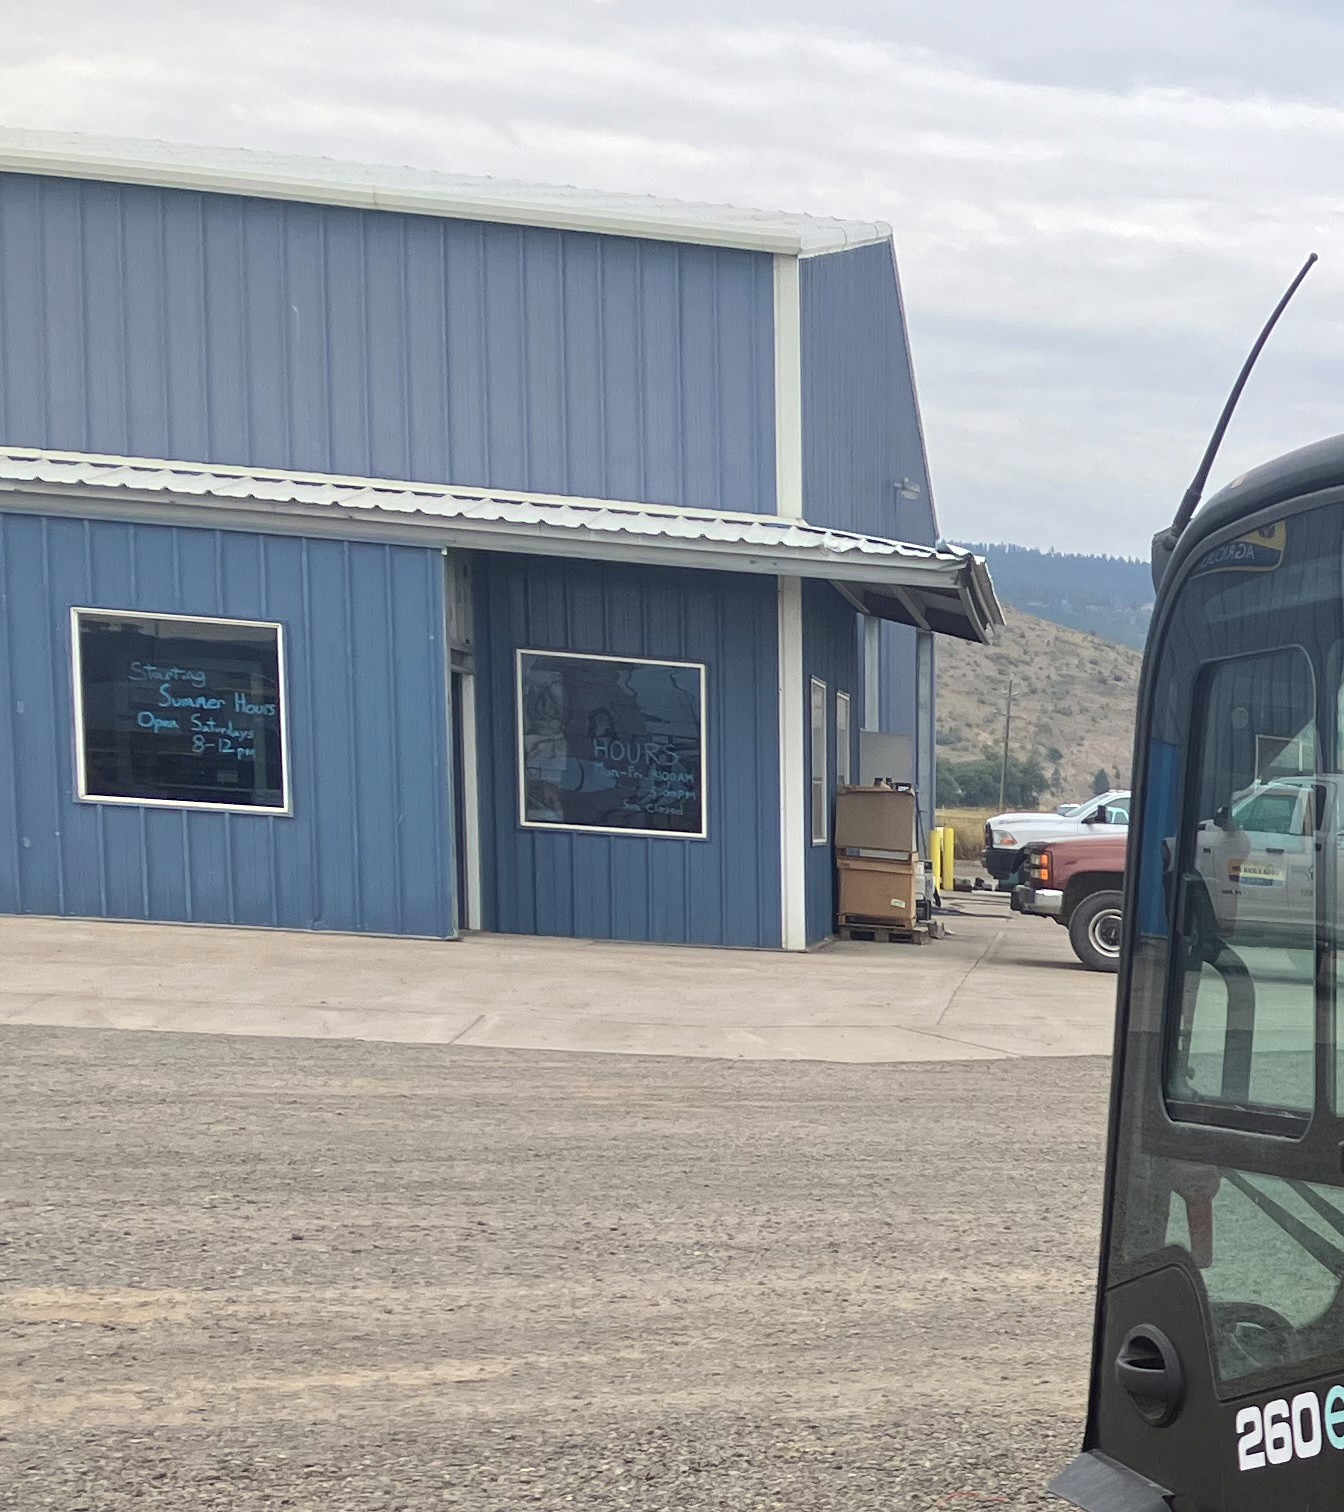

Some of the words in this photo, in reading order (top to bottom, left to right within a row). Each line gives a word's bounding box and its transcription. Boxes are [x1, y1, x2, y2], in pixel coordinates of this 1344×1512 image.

[128, 661, 206, 688] Starting
[158, 683, 226, 709] Summer
[234, 691, 276, 716] Hours
[137, 711, 180, 734] Open
[190, 713, 255, 743] Saturdays
[593, 738, 680, 766] HOURS
